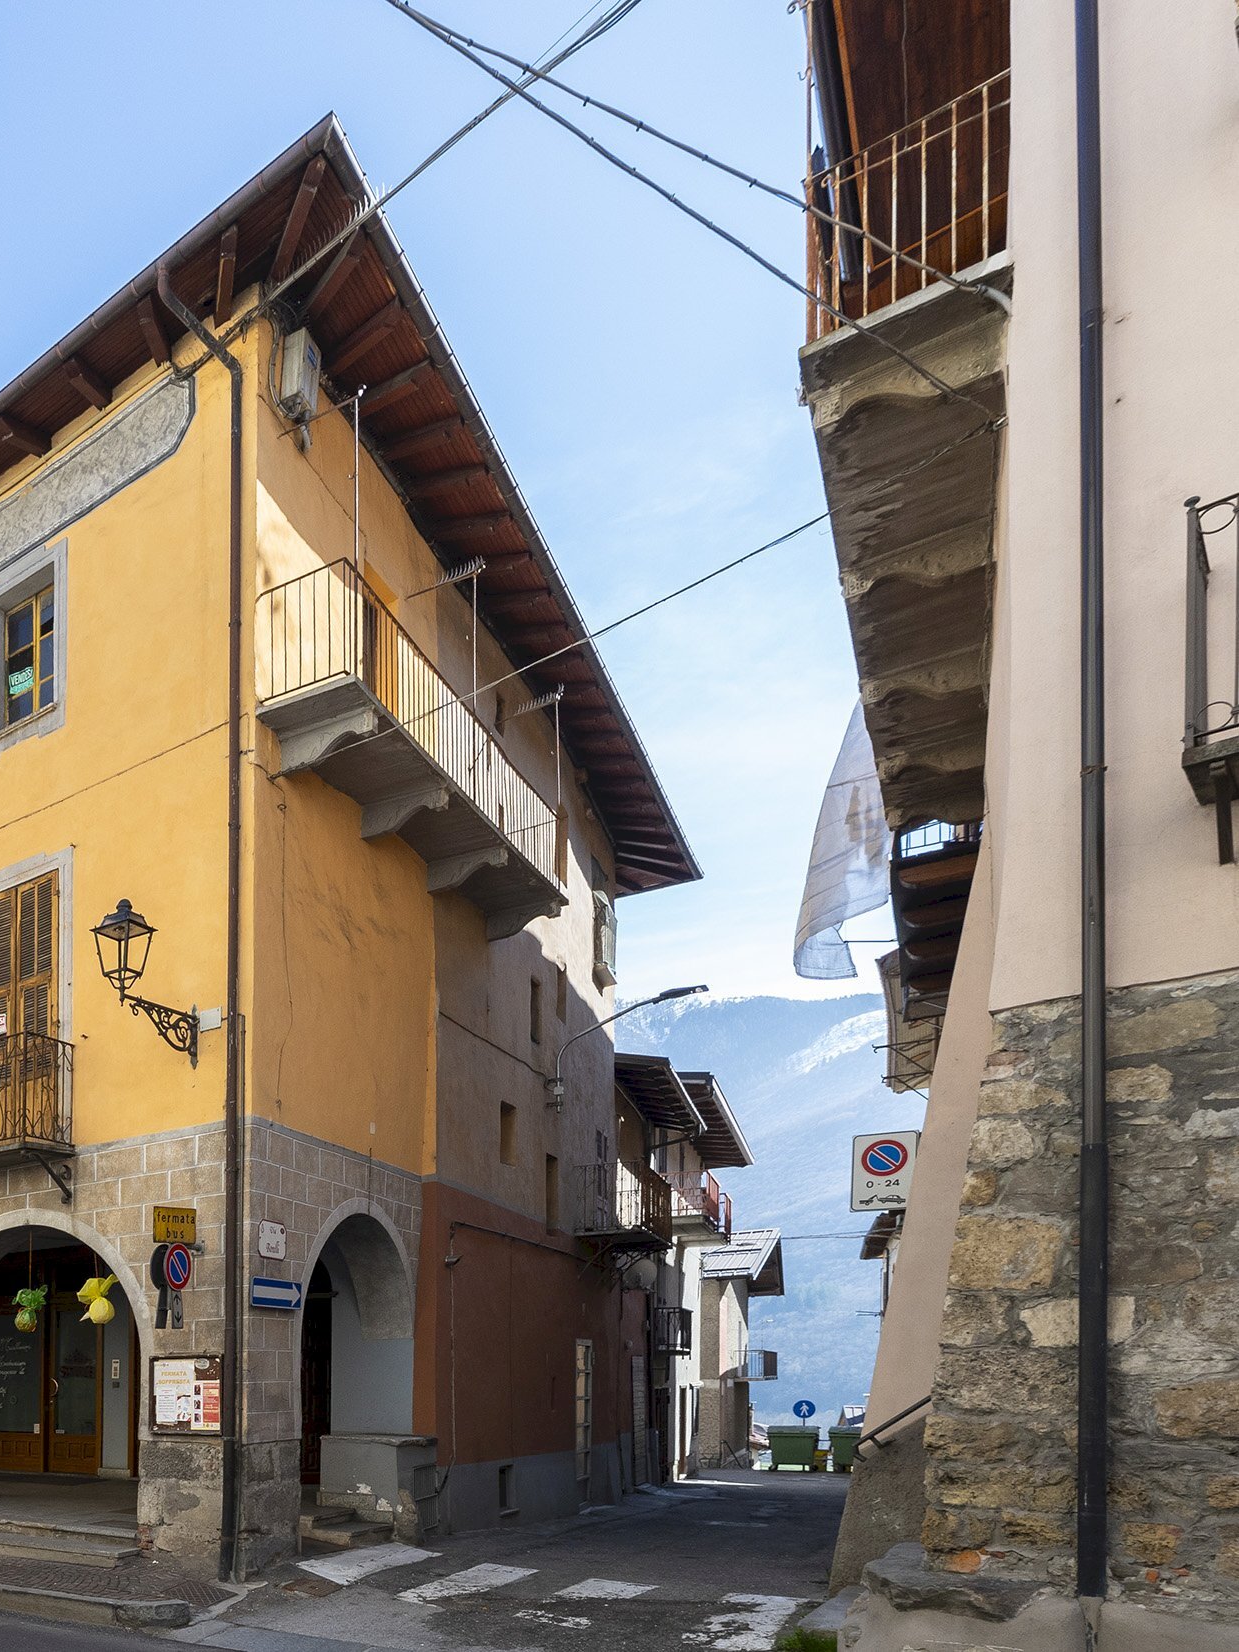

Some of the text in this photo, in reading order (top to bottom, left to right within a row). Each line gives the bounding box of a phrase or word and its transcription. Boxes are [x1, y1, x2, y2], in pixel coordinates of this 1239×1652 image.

[885, 1179, 900, 1187] 24
[157, 1210, 195, 1224] fermata
[166, 1228, 184, 1238] bus
